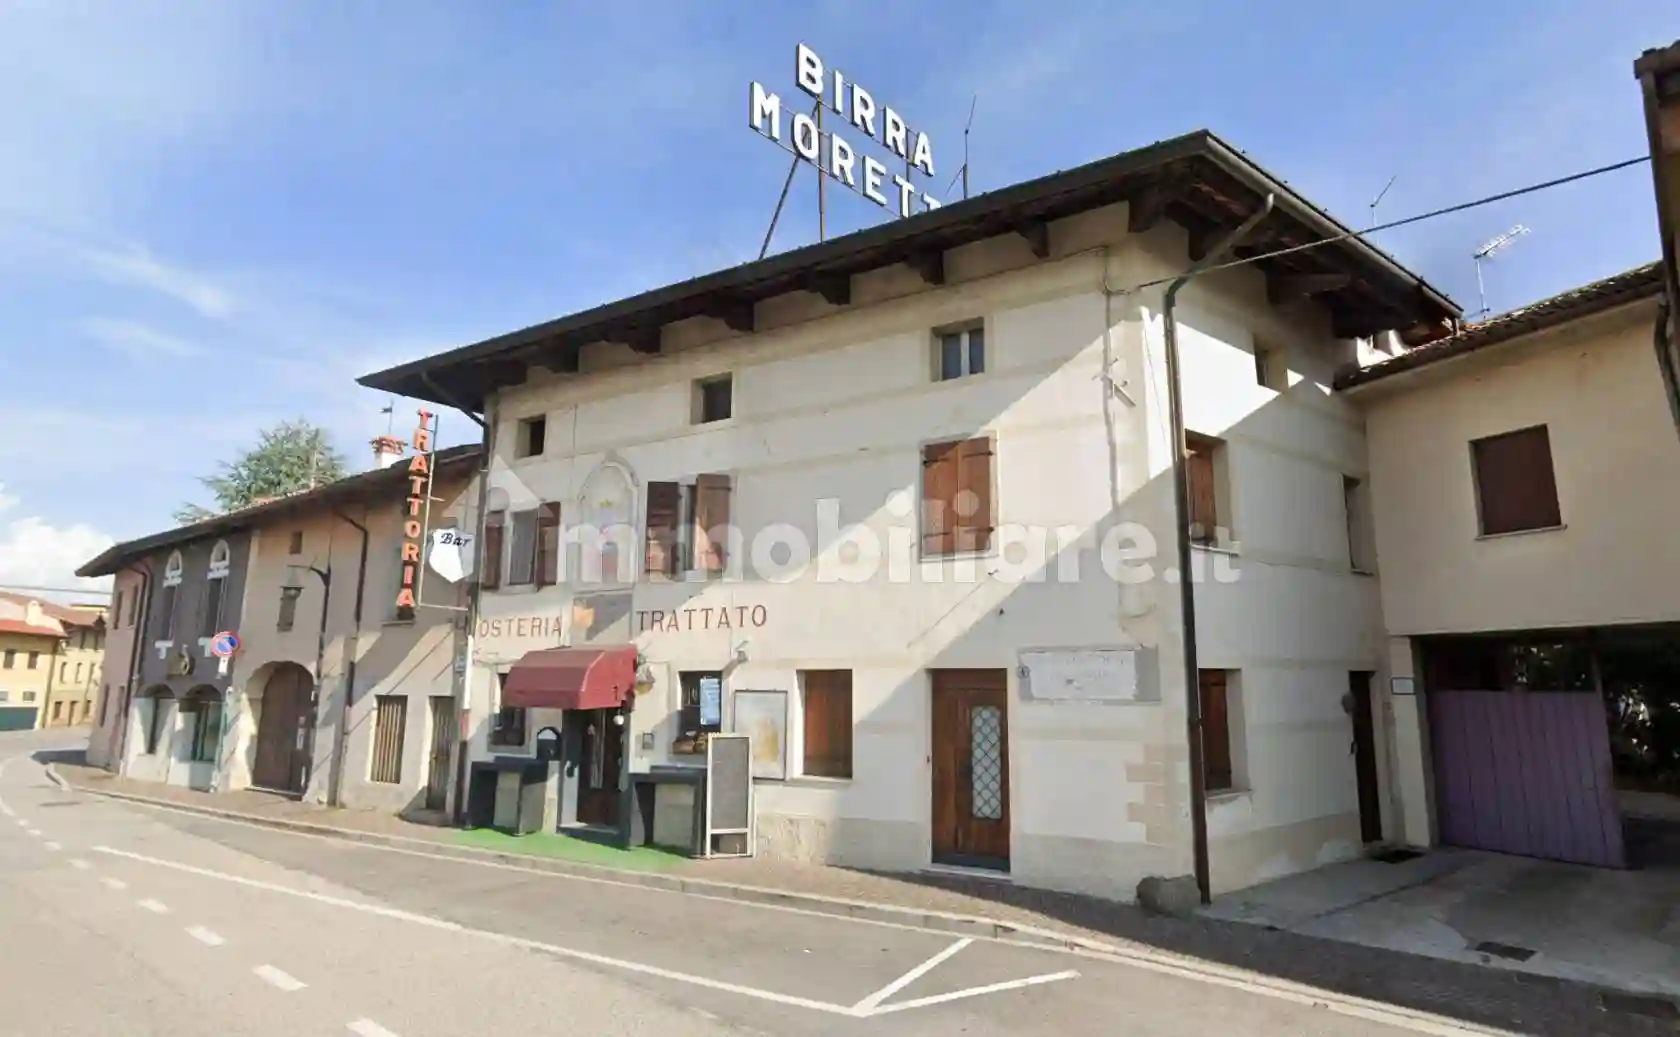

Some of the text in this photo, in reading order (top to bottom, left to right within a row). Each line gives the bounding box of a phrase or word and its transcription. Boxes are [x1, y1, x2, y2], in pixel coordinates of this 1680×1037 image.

[796, 42, 935, 177] BIRRA
[396, 407, 433, 607] TRATTORIA
[440, 532, 472, 547] Bar
[479, 604, 767, 638] OSTERIA TRATTATO
